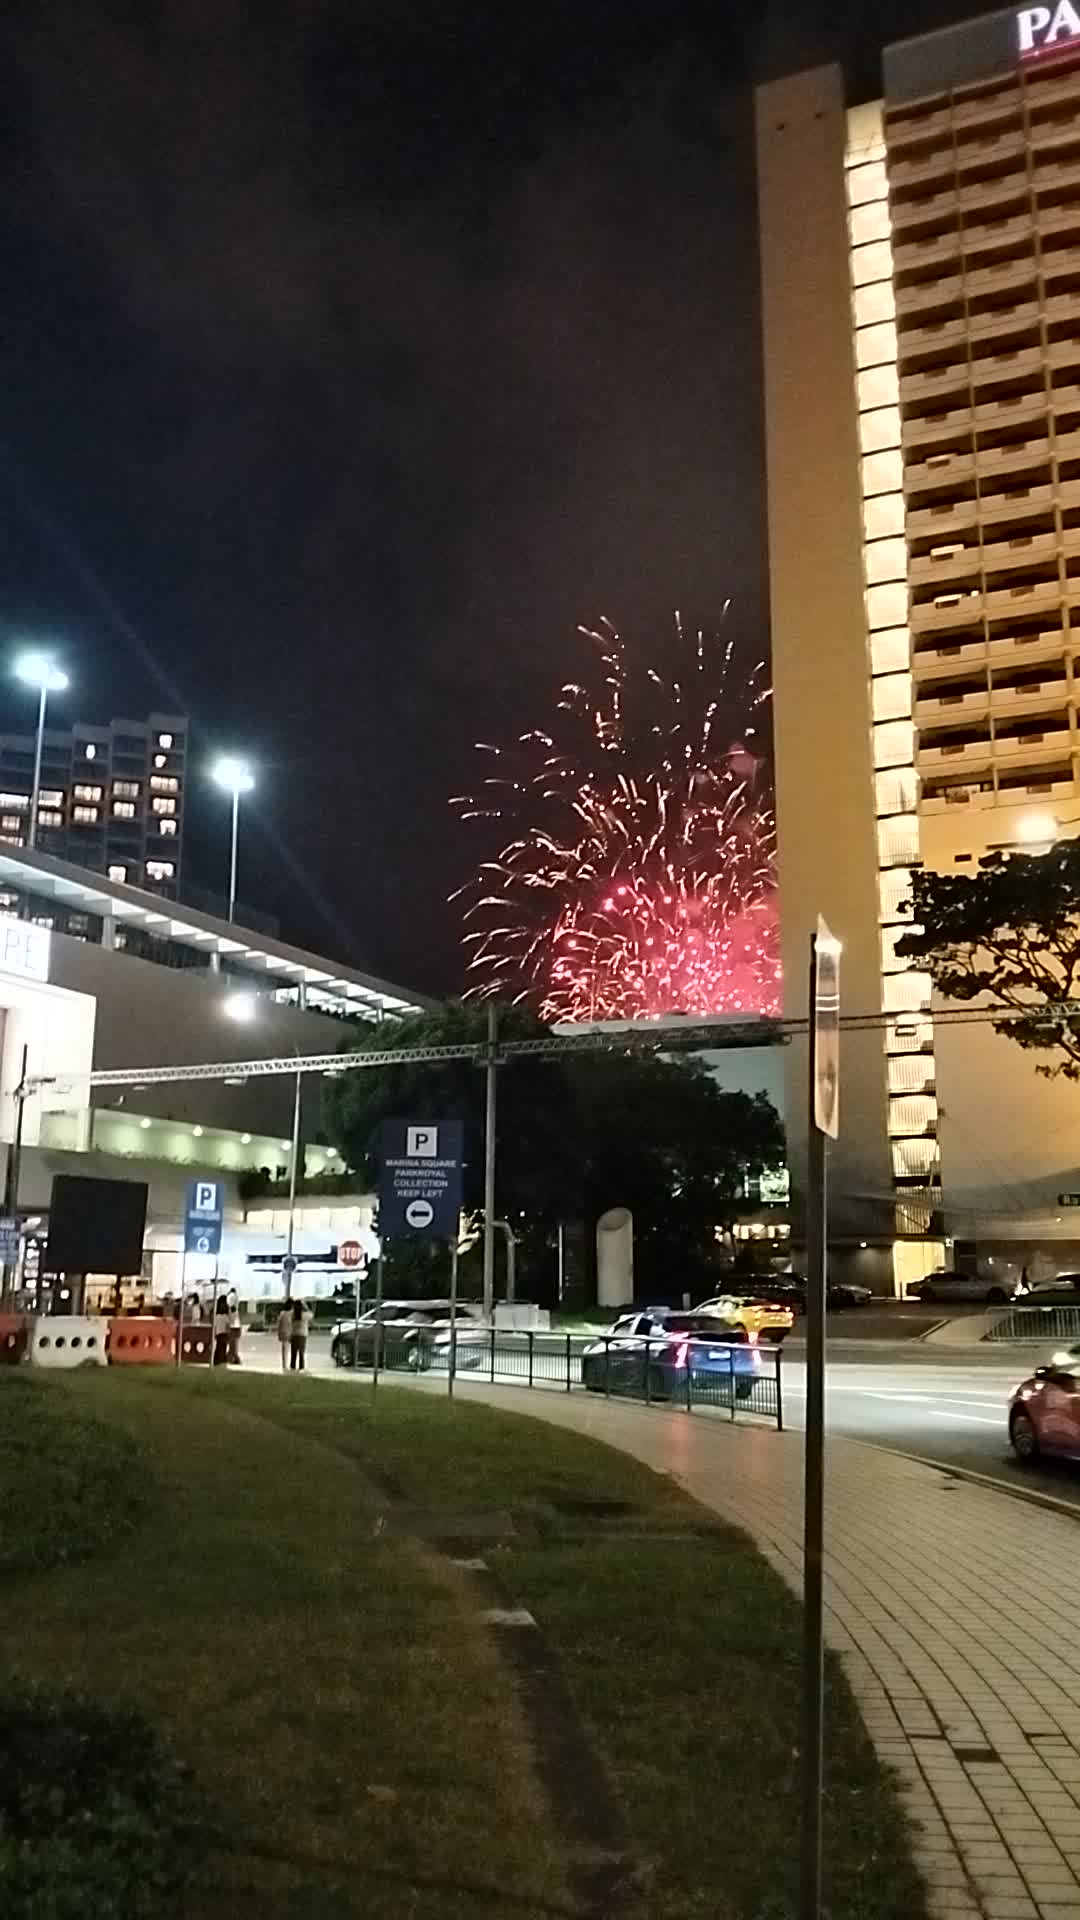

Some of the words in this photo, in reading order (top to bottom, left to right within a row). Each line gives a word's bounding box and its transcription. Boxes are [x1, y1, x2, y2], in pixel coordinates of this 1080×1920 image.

[415, 1133, 428, 1150] P
[386, 1159, 419, 1167] MARINA
[421, 1159, 457, 1168] SQUARE
[395, 1169, 446, 1178] PARKROYAL
[394, 1179, 448, 1187] COLLECTION
[200, 1187, 212, 1206] P
[397, 1189, 420, 1198] KEEP
[421, 1189, 442, 1198] LEFT
